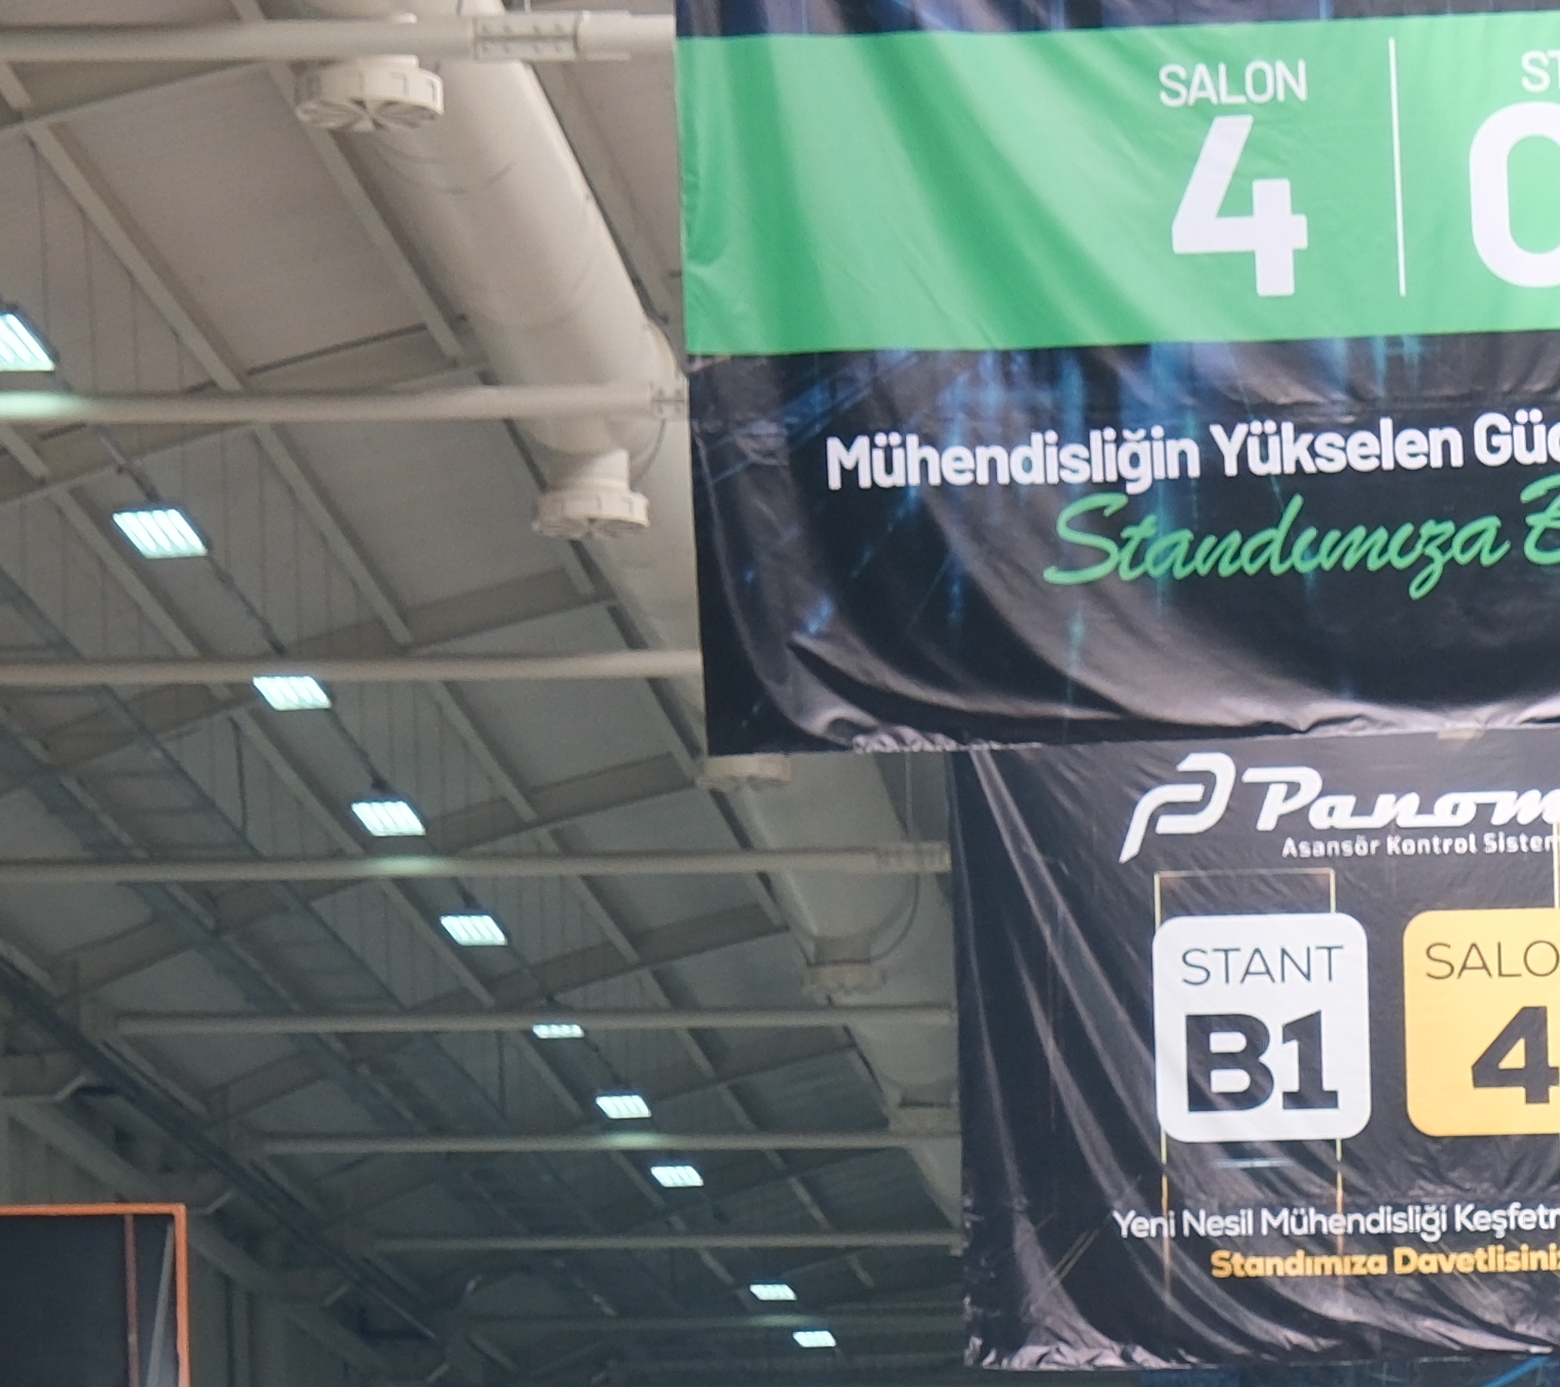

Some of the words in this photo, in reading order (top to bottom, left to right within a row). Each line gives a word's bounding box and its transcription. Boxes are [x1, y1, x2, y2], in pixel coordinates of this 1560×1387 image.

[1158, 58, 1308, 110] SALON
[1171, 114, 1308, 296] 4
[827, 421, 1200, 494] Mühendisliğin
[1210, 413, 1464, 481] Yükselen
[1282, 831, 1380, 858] Asansör
[1386, 831, 1477, 856] Kontrol
[1181, 944, 1345, 986] STANT
[1185, 1009, 1339, 1112] B1
[1470, 1004, 1560, 1105] 4
[1113, 1208, 1176, 1240] Yeni
[1183, 1207, 1253, 1237] Nesil
[1261, 1204, 1448, 1241] Mühendisliği
[1211, 1248, 1388, 1278] Standımıza
